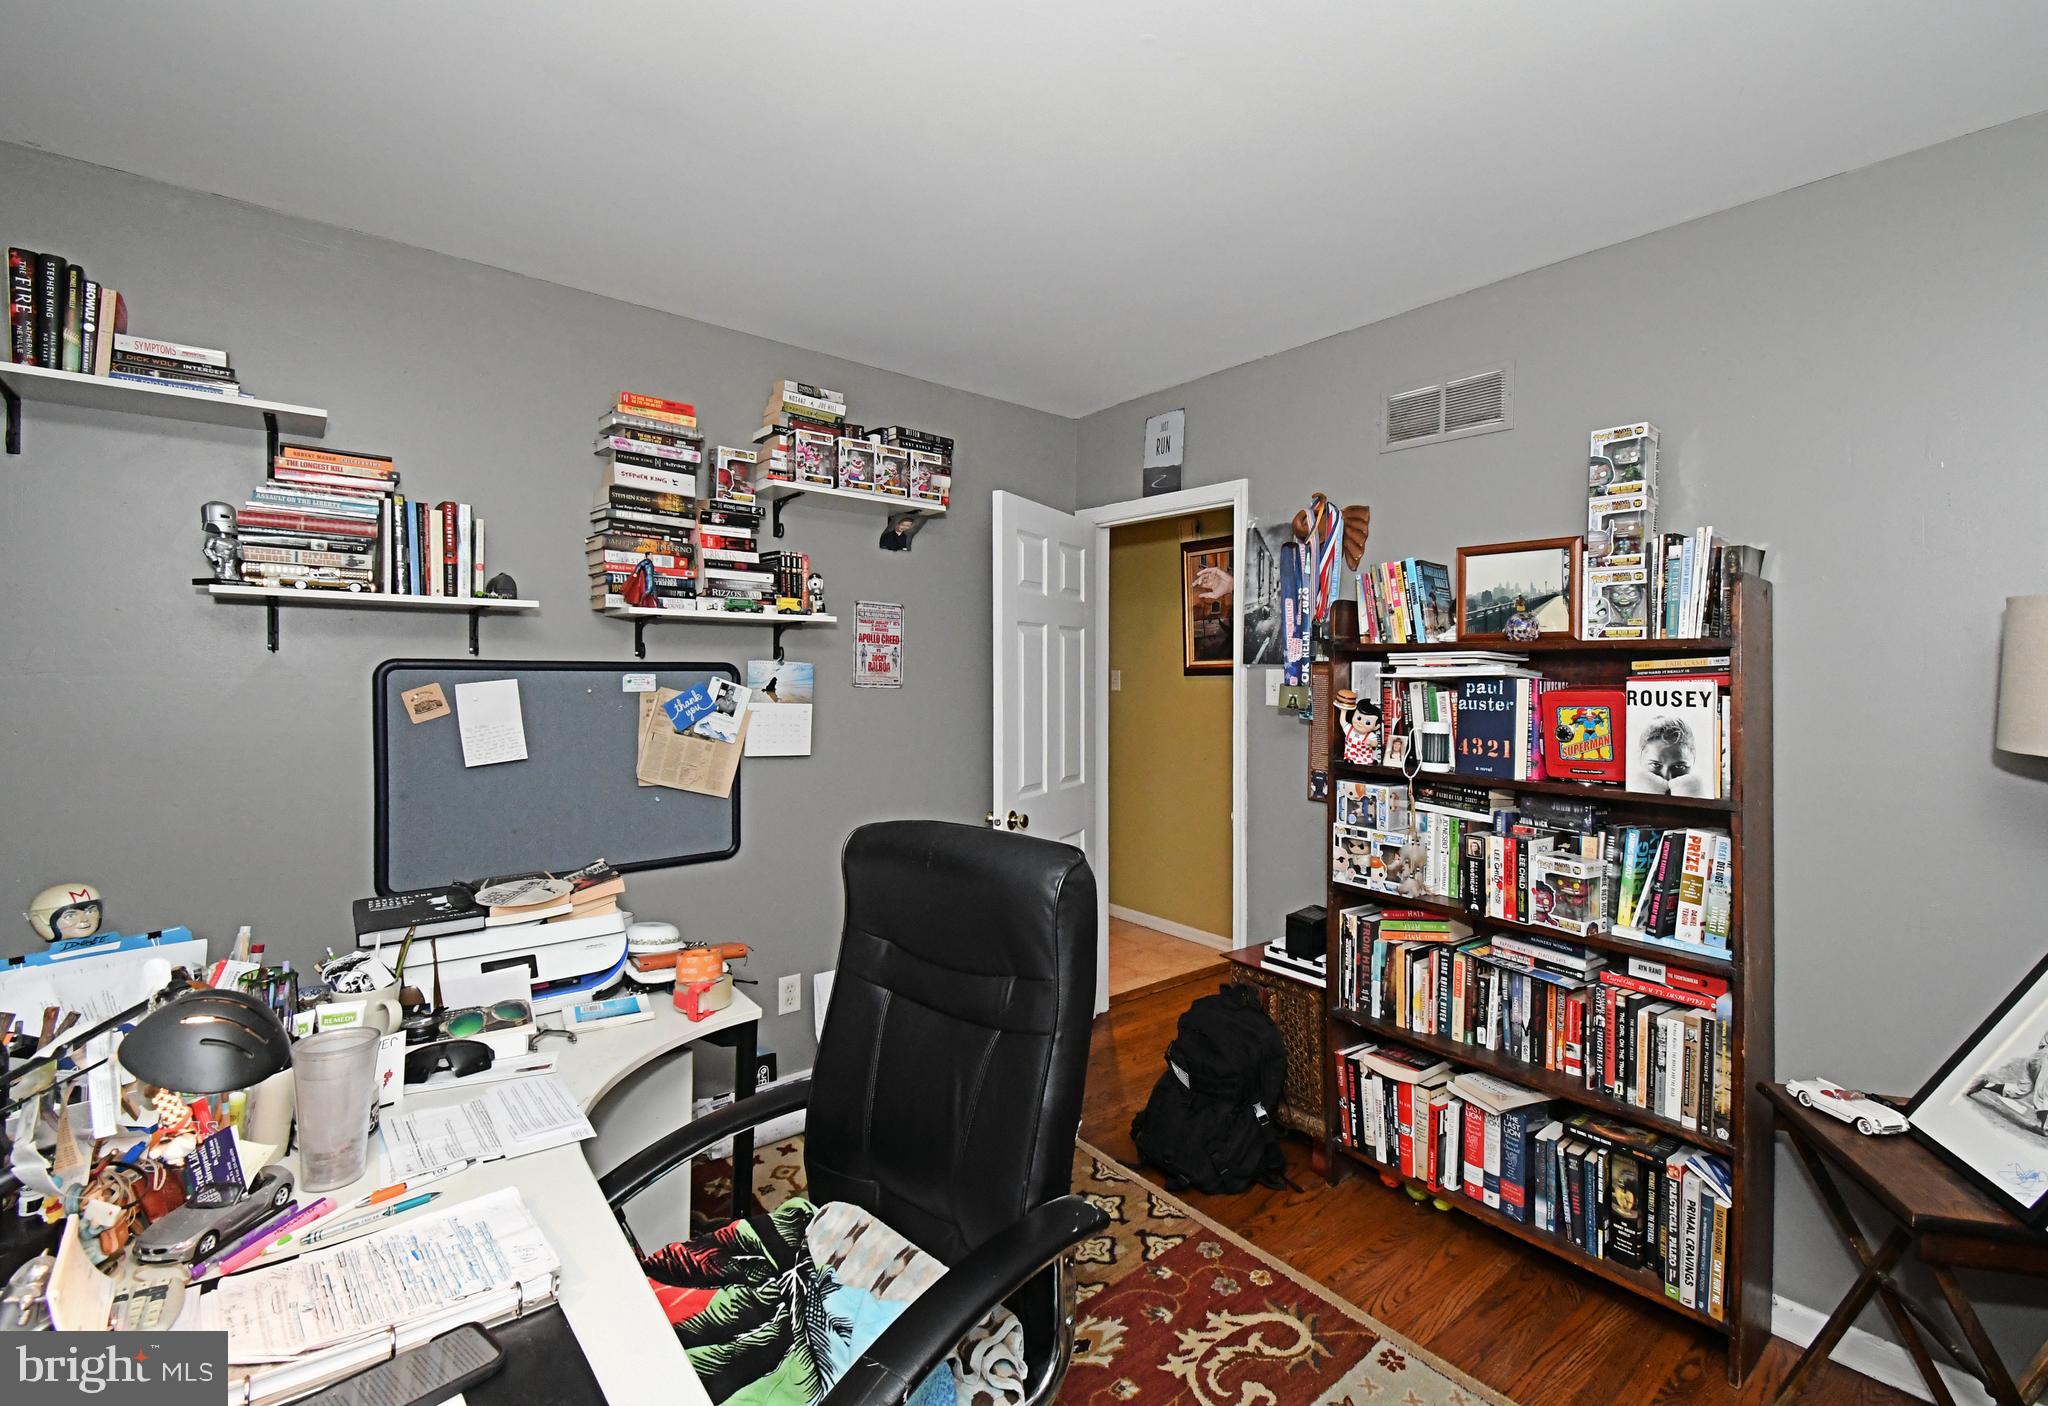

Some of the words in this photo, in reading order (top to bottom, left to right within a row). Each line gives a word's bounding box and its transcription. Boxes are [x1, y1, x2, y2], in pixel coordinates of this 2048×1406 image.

[46, 262, 55, 297] STEPHEN
[15, 276, 32, 314] FIRE
[85, 282, 96, 323] BEOWULF
[46, 298, 54, 318] KING
[16, 325, 24, 354] NEVILLE
[134, 340, 176, 356] SYMPTOMS
[126, 354, 150, 363] DICK
[152, 358, 179, 368] WOLF
[183, 364, 232, 377] INTERCEPT
[1160, 421, 1168, 432] JUST
[1156, 435, 1170, 456] RUN
[300, 461, 330, 472] LONGEST
[618, 454, 640, 462] STEPHEN
[620, 471, 648, 480] STEPHEN
[650, 476, 668, 484] KING
[256, 493, 284, 502] ASSAULT
[298, 498, 311, 506] THE
[611, 492, 635, 500] STEPHEN
[302, 551, 342, 560] CITIZEN
[858, 633, 880, 644] APOLLO
[881, 635, 900, 644] CREED
[868, 662, 890, 672] BALBOA
[1665, 660, 1682, 668] FAIR
[1466, 680, 1504, 697] paul
[674, 690, 702, 712] thank
[1458, 698, 1514, 712] auster
[1627, 690, 1712, 708] ROUSEY
[685, 704, 700, 722] you
[1458, 737, 1511, 758] 4321
[1562, 734, 1611, 758] SUPERMAN
[1464, 788, 1486, 796] ENIGMA
[1442, 818, 1448, 826] JO
[1520, 818, 1534, 826] JOHN
[1535, 819, 1548, 828] WICK
[1686, 835, 1701, 872] PRIZE
[1719, 842, 1727, 860] GREAT
[1493, 863, 1501, 884] CHILD
[1715, 861, 1725, 884] DELUGE
[69, 888, 90, 904] M
[1652, 902, 1660, 914] GREAT
[1681, 907, 1690, 925] YERGIN
[1690, 909, 1698, 926] DANIEL
[1717, 910, 1726, 933] DOUGLAS
[1362, 922, 1371, 954] FROM
[1362, 956, 1371, 985] HELL
[1440, 958, 1448, 975] LONG
[1638, 963, 1648, 972] AYN
[1648, 965, 1662, 976] RAND
[1439, 976, 1448, 1001] BRIGHT
[1622, 978, 1635, 987] Otis
[1638, 985, 1665, 998] BEAUTY,
[1666, 992, 1706, 1006] DISRUPTED
[324, 1015, 356, 1024] REMEDY
[1439, 1002, 1447, 1022] RIVER
[1619, 1039, 1624, 1048] ON
[1465, 1109, 1482, 1120] LION
[1506, 1114, 1518, 1123] THE
[1504, 1120, 1520, 1131] LAST
[1504, 1126, 1520, 1138] LION
[432, 1166, 448, 1176] FOX
[1647, 1189, 1655, 1212] CONNELLY
[1668, 1180, 1677, 1233] PRACTICAL
[1685, 1199, 1696, 1235] PRIMAL
[1714, 1209, 1724, 1227] DAVID
[1714, 1228, 1723, 1255] GOGGINS
[1668, 1235, 1677, 1266] PALEO
[1684, 1237, 1695, 1288] CRAVINGS
[1713, 1259, 1722, 1277] CAN'T
[1713, 1277, 1721, 1295] HURT
[1713, 1295, 1721, 1304] ME
